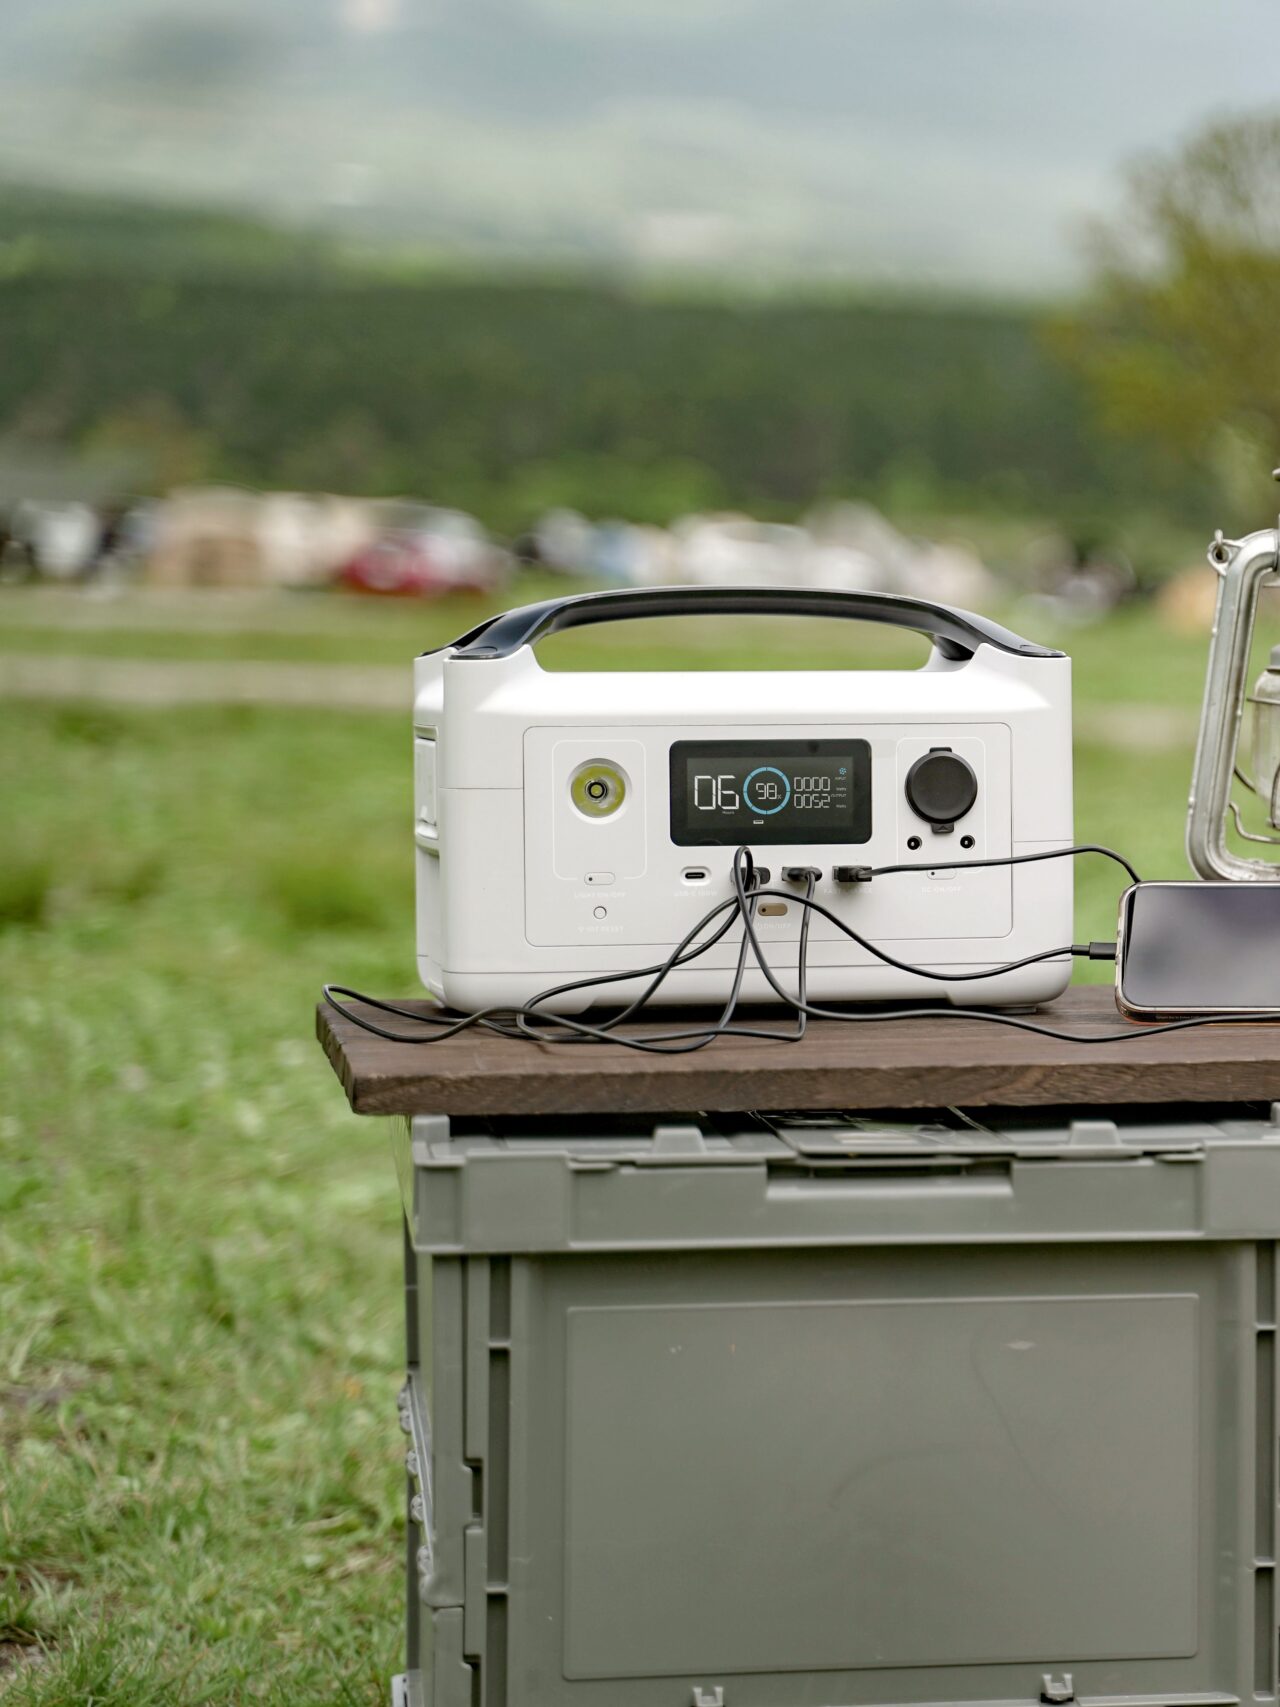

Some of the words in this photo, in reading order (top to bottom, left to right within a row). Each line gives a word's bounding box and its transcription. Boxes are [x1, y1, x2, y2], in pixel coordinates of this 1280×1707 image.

[793, 776, 831, 792] 0000
[694, 775, 740, 810] 06
[793, 793, 831, 809] 0052
